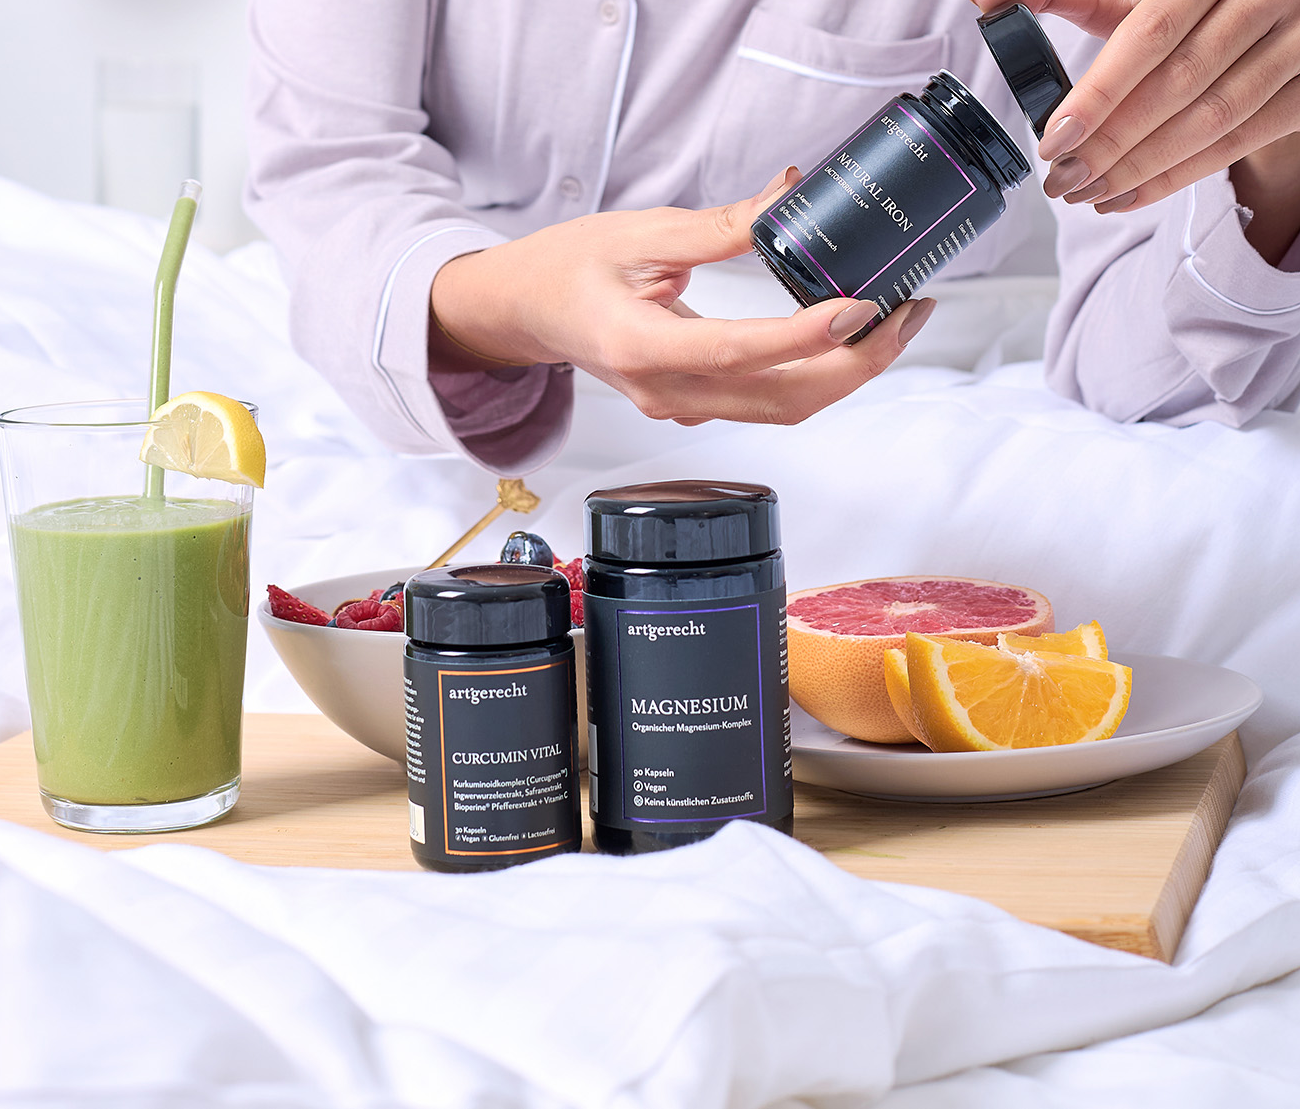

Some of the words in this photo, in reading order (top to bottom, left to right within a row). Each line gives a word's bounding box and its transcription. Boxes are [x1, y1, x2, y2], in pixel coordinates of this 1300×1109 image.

[824, 166, 855, 195] LACTOFERRIN
[837, 152, 883, 200] NATURAL
[880, 197, 913, 232] IRON
[814, 224, 838, 252] Vegetarisch
[632, 695, 748, 715] MAGNESIUM
[632, 722, 675, 733] Organischer
[677, 718, 752, 733] Magnesium-Komplex
[452, 750, 527, 764] CURCUMIN
[530, 744, 561, 760] VITAL
[634, 769, 643, 777] 90
[645, 768, 674, 778] Kapseln
[454, 780, 525, 788] Kurkuminoidkomplex
[454, 790, 524, 800] Ingwerwurzelextrakt,
[525, 783, 562, 796] Safranextrakt
[644, 783, 666, 793] Vegan
[492, 801, 537, 811] Pfefferextrakt
[544, 794, 563, 804] Vitamin
[645, 797, 665, 806] Keine
[666, 797, 709, 806] künstlichen
[711, 791, 753, 805] Zusatzstoffe
[462, 835, 480, 843] Vegan
[489, 834, 519, 842] Glutenfrei
[528, 828, 555, 839] Lactosefrei
